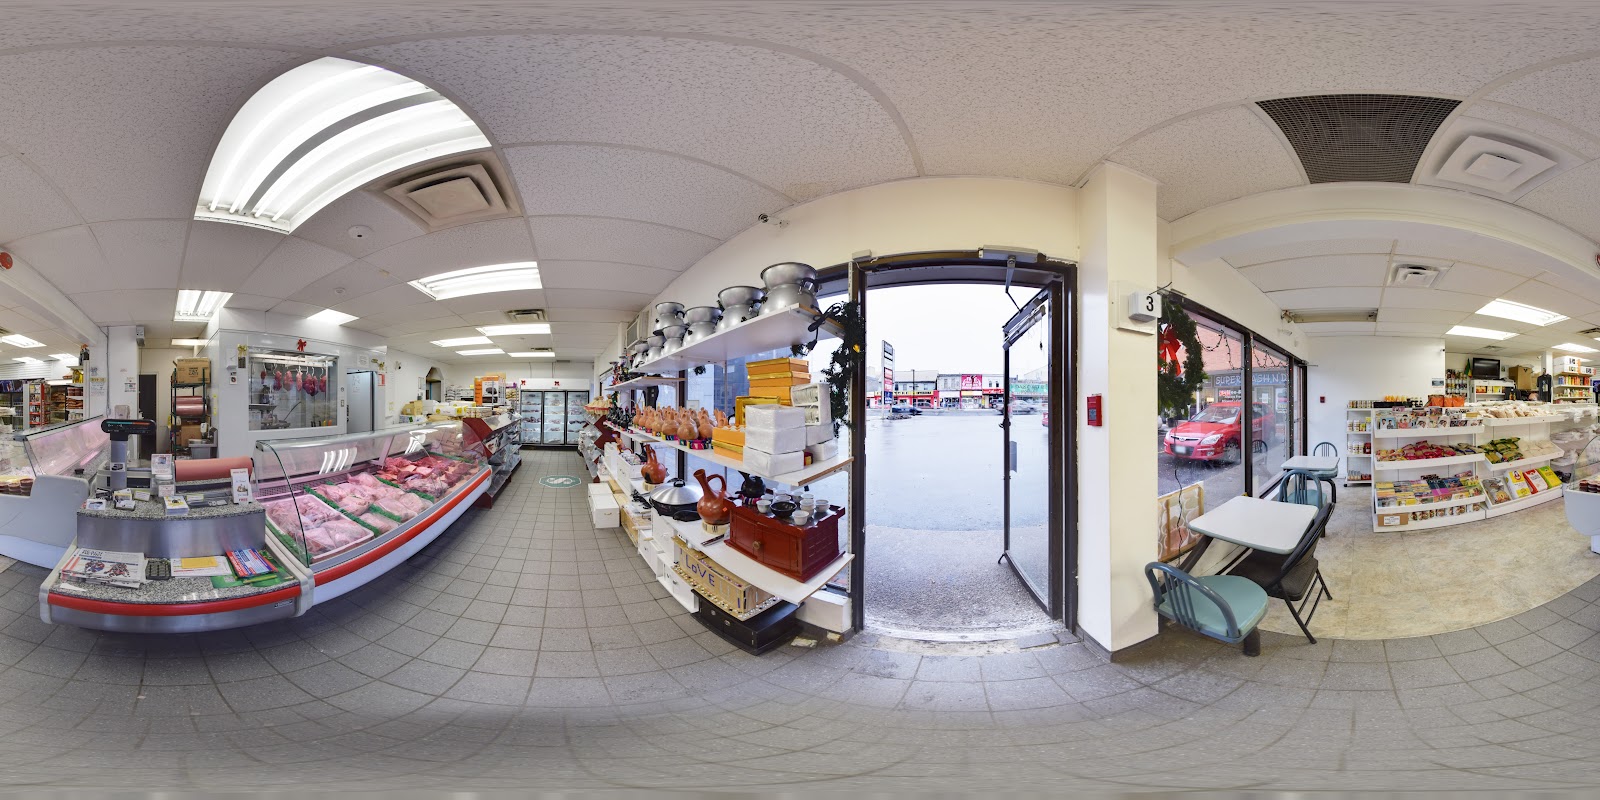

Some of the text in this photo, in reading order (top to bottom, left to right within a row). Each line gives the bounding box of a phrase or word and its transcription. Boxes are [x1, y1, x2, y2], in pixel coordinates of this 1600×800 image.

[1146, 295, 1154, 312] 3
[1215, 375, 1241, 385] SUPER
[1252, 373, 1270, 383] ASH
